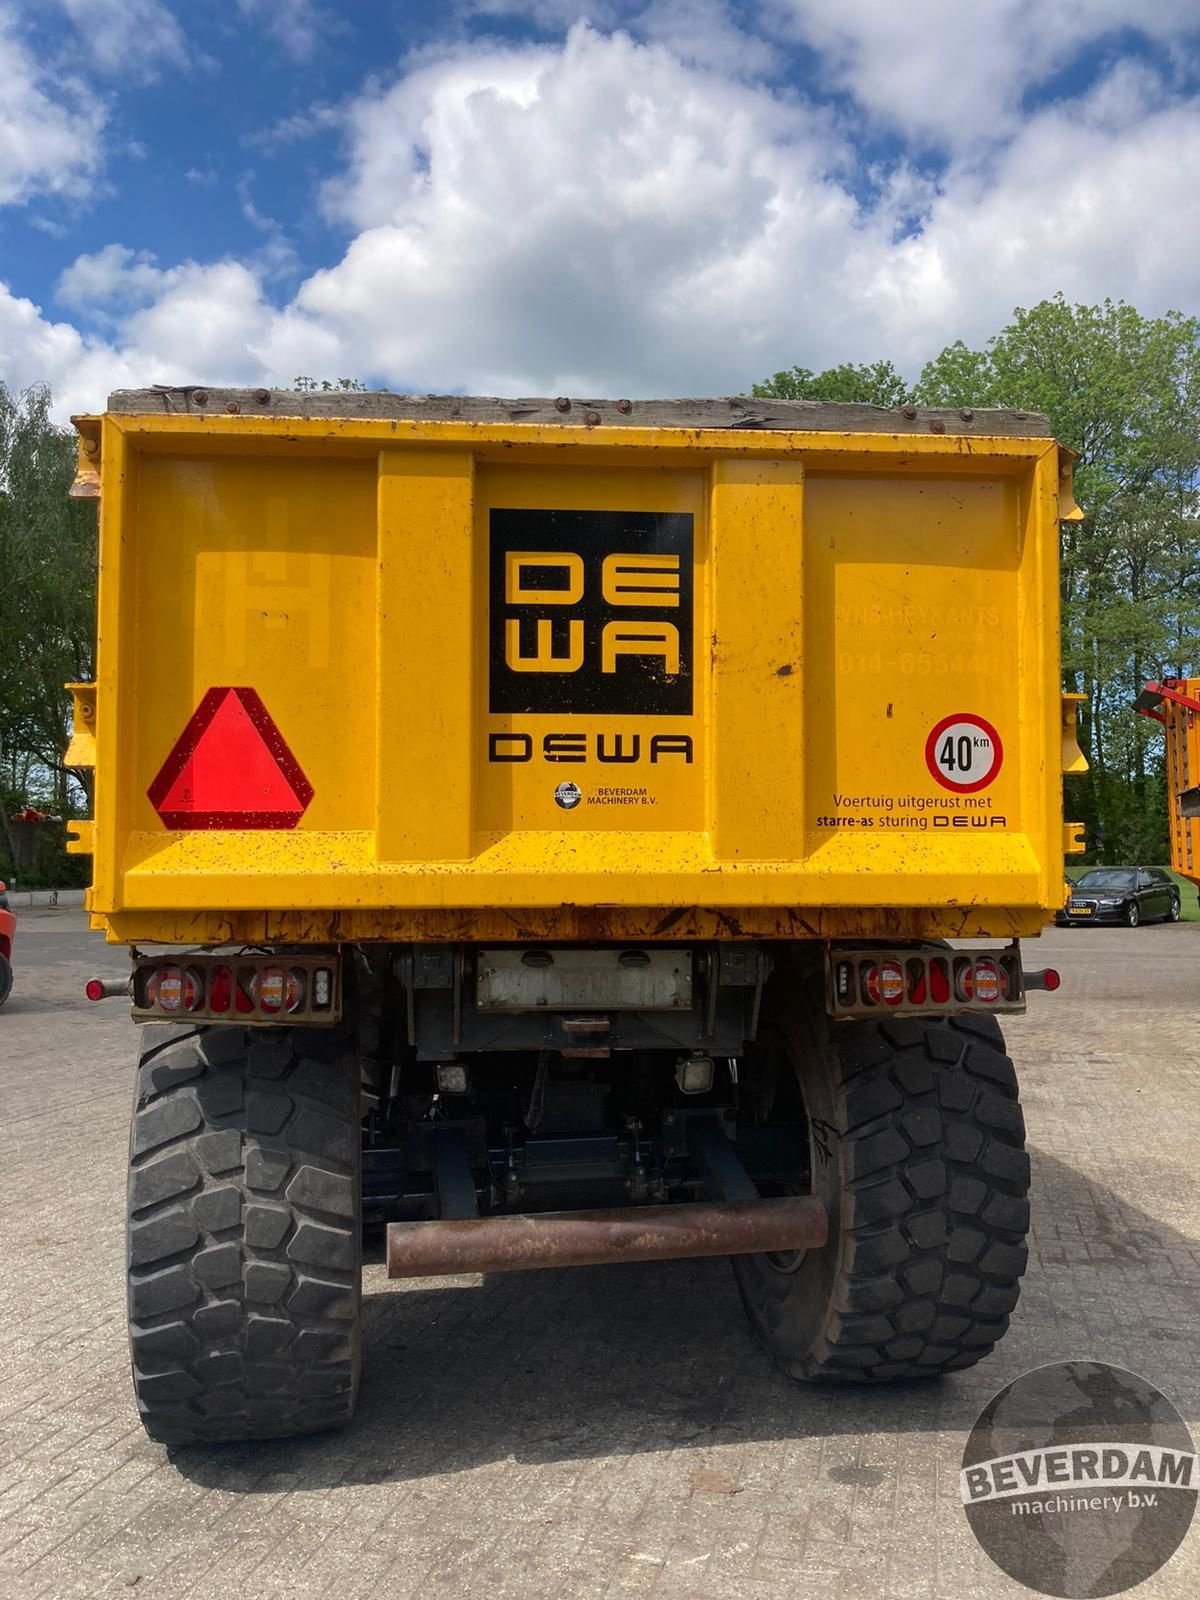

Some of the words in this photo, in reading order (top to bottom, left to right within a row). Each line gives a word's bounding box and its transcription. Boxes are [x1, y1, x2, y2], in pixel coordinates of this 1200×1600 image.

[488, 732, 693, 763] DEWA
[939, 735, 973, 772] 40
[973, 736, 990, 748] km
[598, 787, 647, 796] BEVERDAM
[587, 796, 640, 805] MACHINERY
[641, 796, 658, 805] B.V.
[833, 794, 894, 810] Voertuig
[897, 794, 961, 811] uitgerust
[964, 796, 992, 808] met
[816, 816, 874, 827] starre-as
[879, 815, 928, 830] sturing
[933, 815, 1007, 827] DEWA
